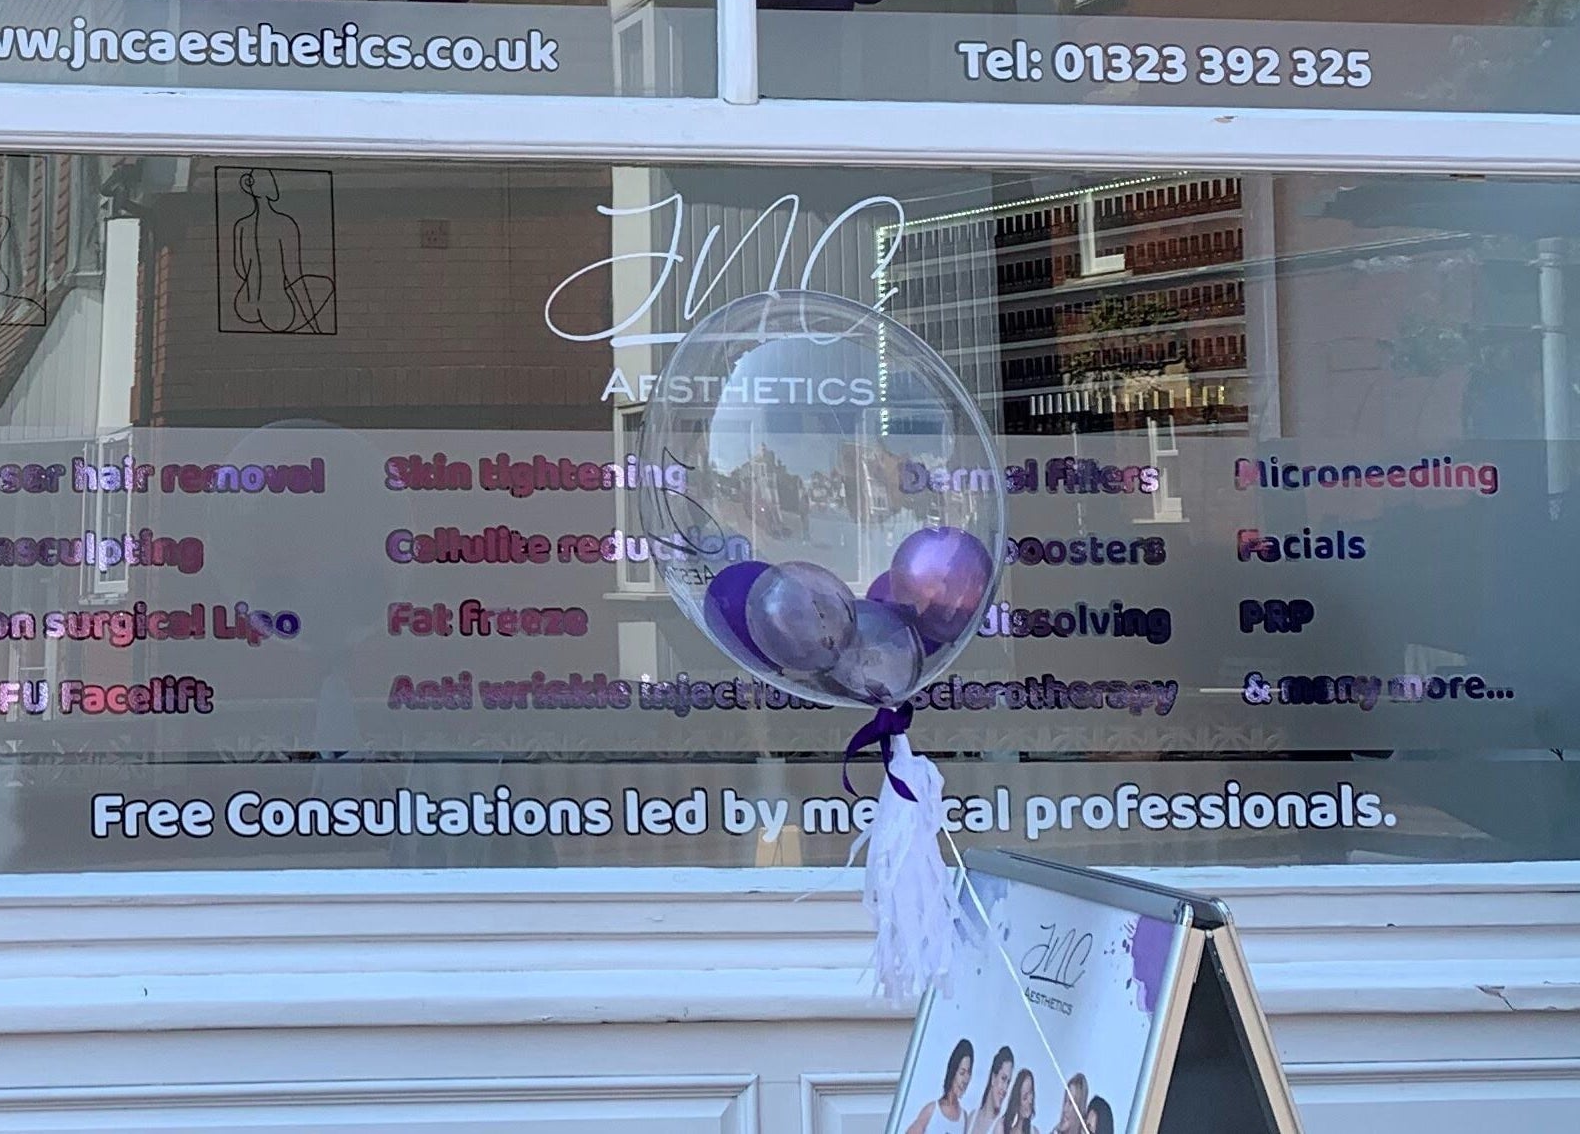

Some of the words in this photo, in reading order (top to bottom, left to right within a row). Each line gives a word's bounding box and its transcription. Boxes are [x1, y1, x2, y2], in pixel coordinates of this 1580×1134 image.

[956, 39, 1044, 83] Tel:
[1053, 43, 1189, 85] 01323
[1196, 45, 1282, 87] 392
[1290, 47, 1374, 90] 325
[72, 454, 154, 493] hair
[161, 458, 326, 494] removal
[385, 452, 472, 491] Skin
[478, 452, 688, 498] tightening
[899, 457, 1038, 494] Dermal
[1045, 456, 1160, 494] Fillers
[1234, 456, 1499, 495] Microneedling
[386, 525, 551, 563] Cellulite
[558, 526, 752, 563] reduction
[1237, 527, 1366, 562] Facials
[44, 600, 205, 648] surgical
[213, 601, 301, 647] Lipo
[388, 601, 453, 636] Fat
[458, 599, 589, 637] freeze
[1239, 599, 1314, 634] PRP
[58, 676, 214, 715] Facelift
[387, 671, 472, 710] Anti
[478, 670, 632, 710] wrinkle
[1242, 671, 1272, 705] &
[1278, 675, 1382, 711] many
[1388, 675, 1514, 703] more...
[91, 792, 215, 839] Free
[224, 785, 613, 838] Consultations
[623, 785, 710, 837] led
[721, 787, 789, 842] by
[802, 785, 1011, 834] mecal
[1022, 779, 1399, 841] professionals.
